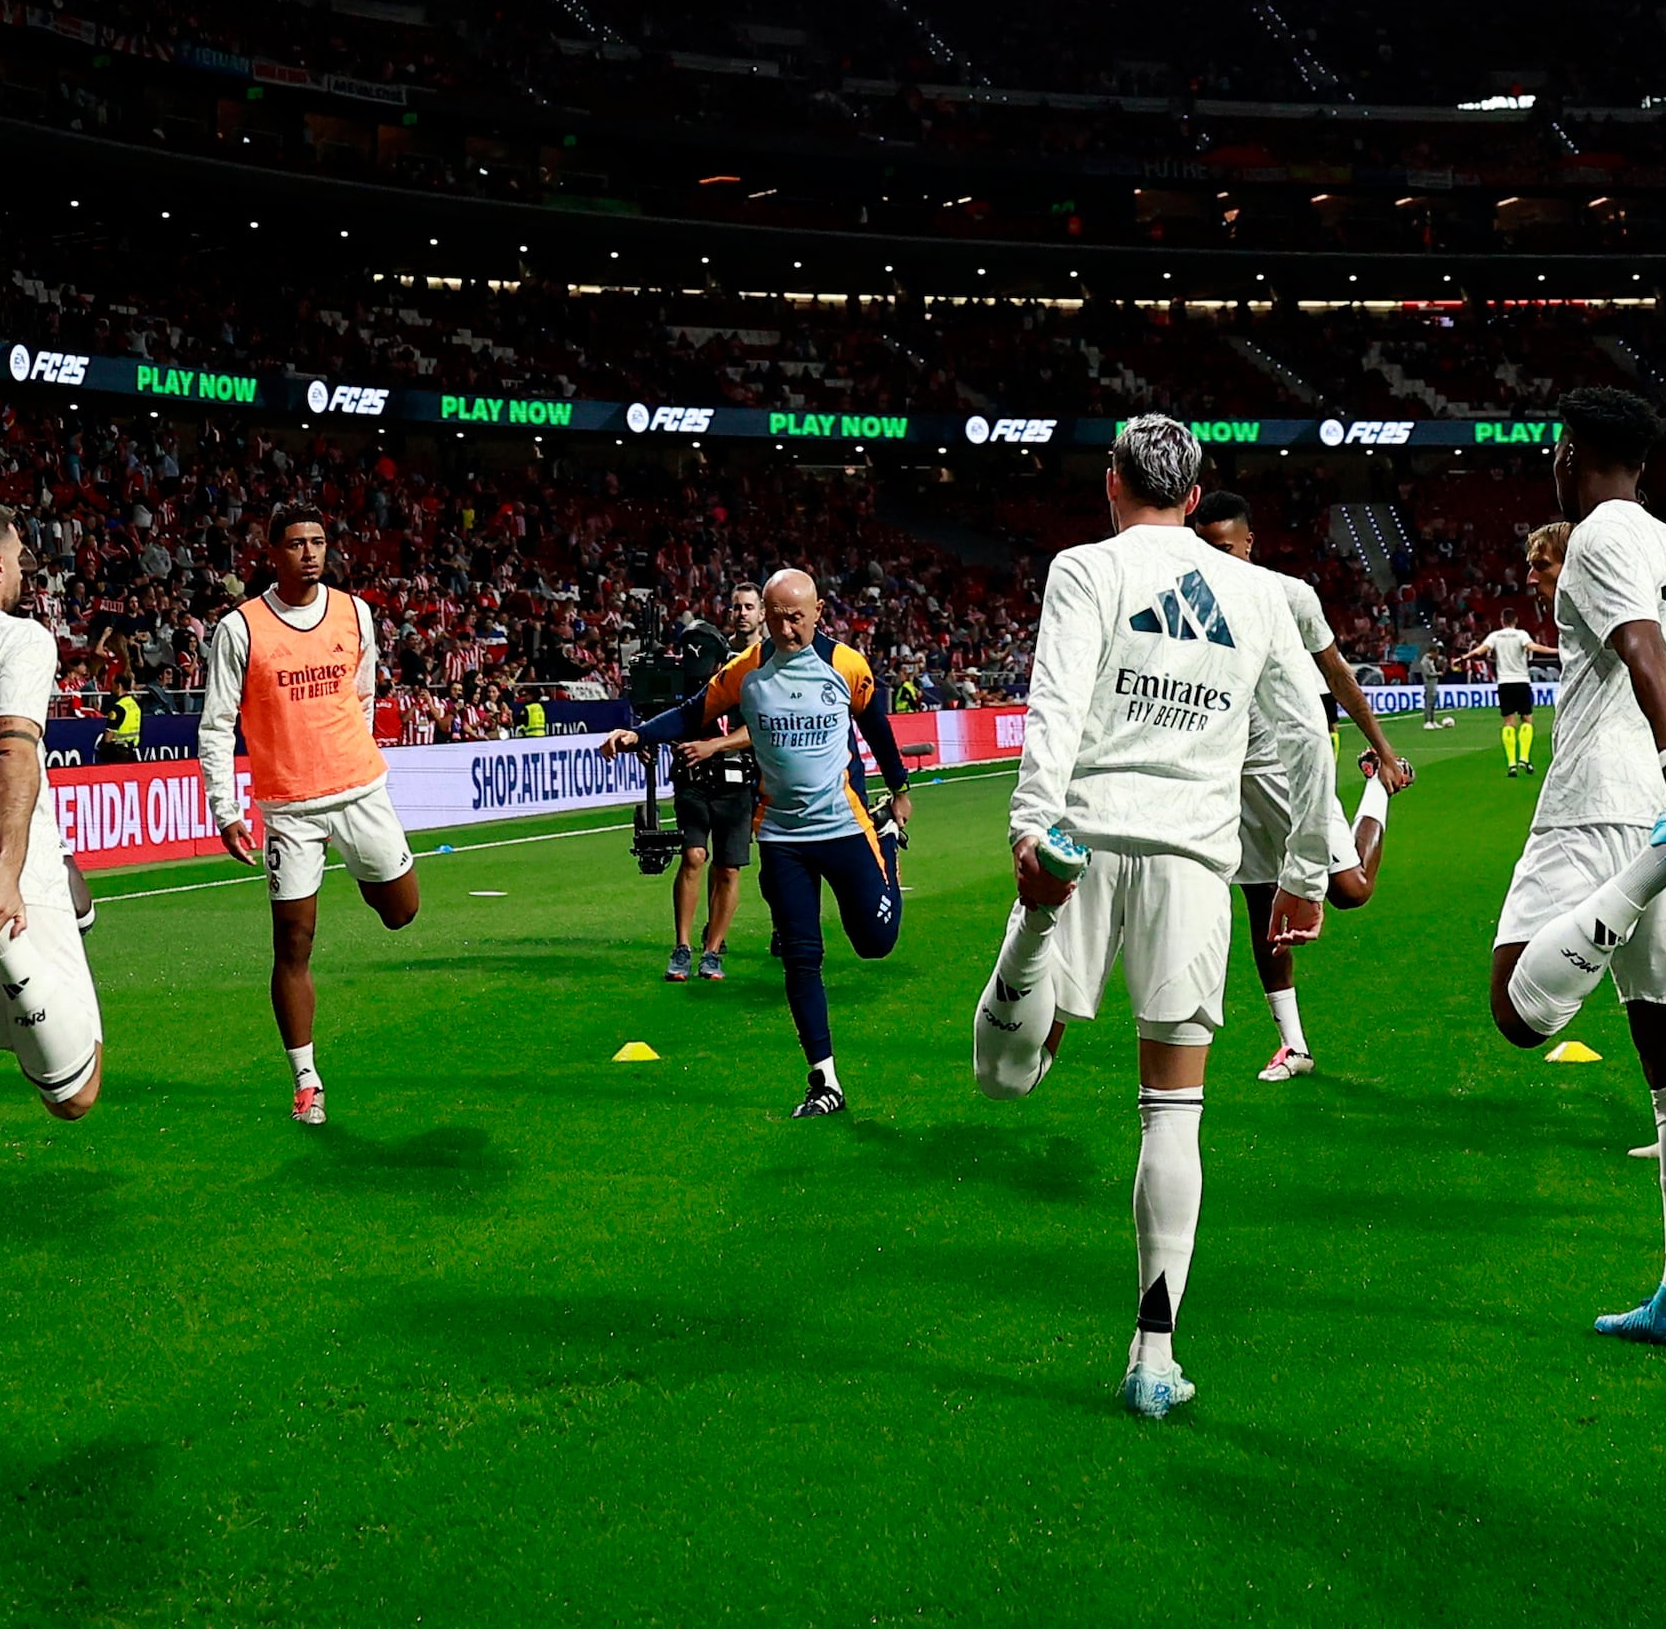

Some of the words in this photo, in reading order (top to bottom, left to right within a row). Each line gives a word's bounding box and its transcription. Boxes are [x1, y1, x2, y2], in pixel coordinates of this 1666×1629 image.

[30, 351, 90, 386] FC25
[137, 365, 195, 396] PLAY
[199, 372, 257, 403] NOW
[328, 385, 390, 415] FC25
[441, 395, 504, 422] PLAY
[508, 399, 573, 426] NOW
[650, 406, 715, 433] FC25
[769, 412, 836, 437] PLAY
[841, 415, 908, 439] NOW
[989, 419, 1058, 444] FC25
[1190, 421, 1260, 444] NOW
[1474, 422, 1546, 444] PLAY
[1344, 421, 1415, 446] FC25
[276, 664, 347, 688] Emirates
[290, 686, 308, 703] FLY
[308, 680, 340, 699] BETTER
[790, 692, 803, 700] AP
[1115, 668, 1232, 712] Emirates
[758, 713, 838, 732] Emirates
[1126, 701, 1155, 724] FLY
[1153, 705, 1209, 732] BETTER
[771, 732, 787, 747] FLY
[790, 730, 829, 748] BETTER
[50, 780, 144, 854] ENDA
[267, 835, 282, 871] 5
